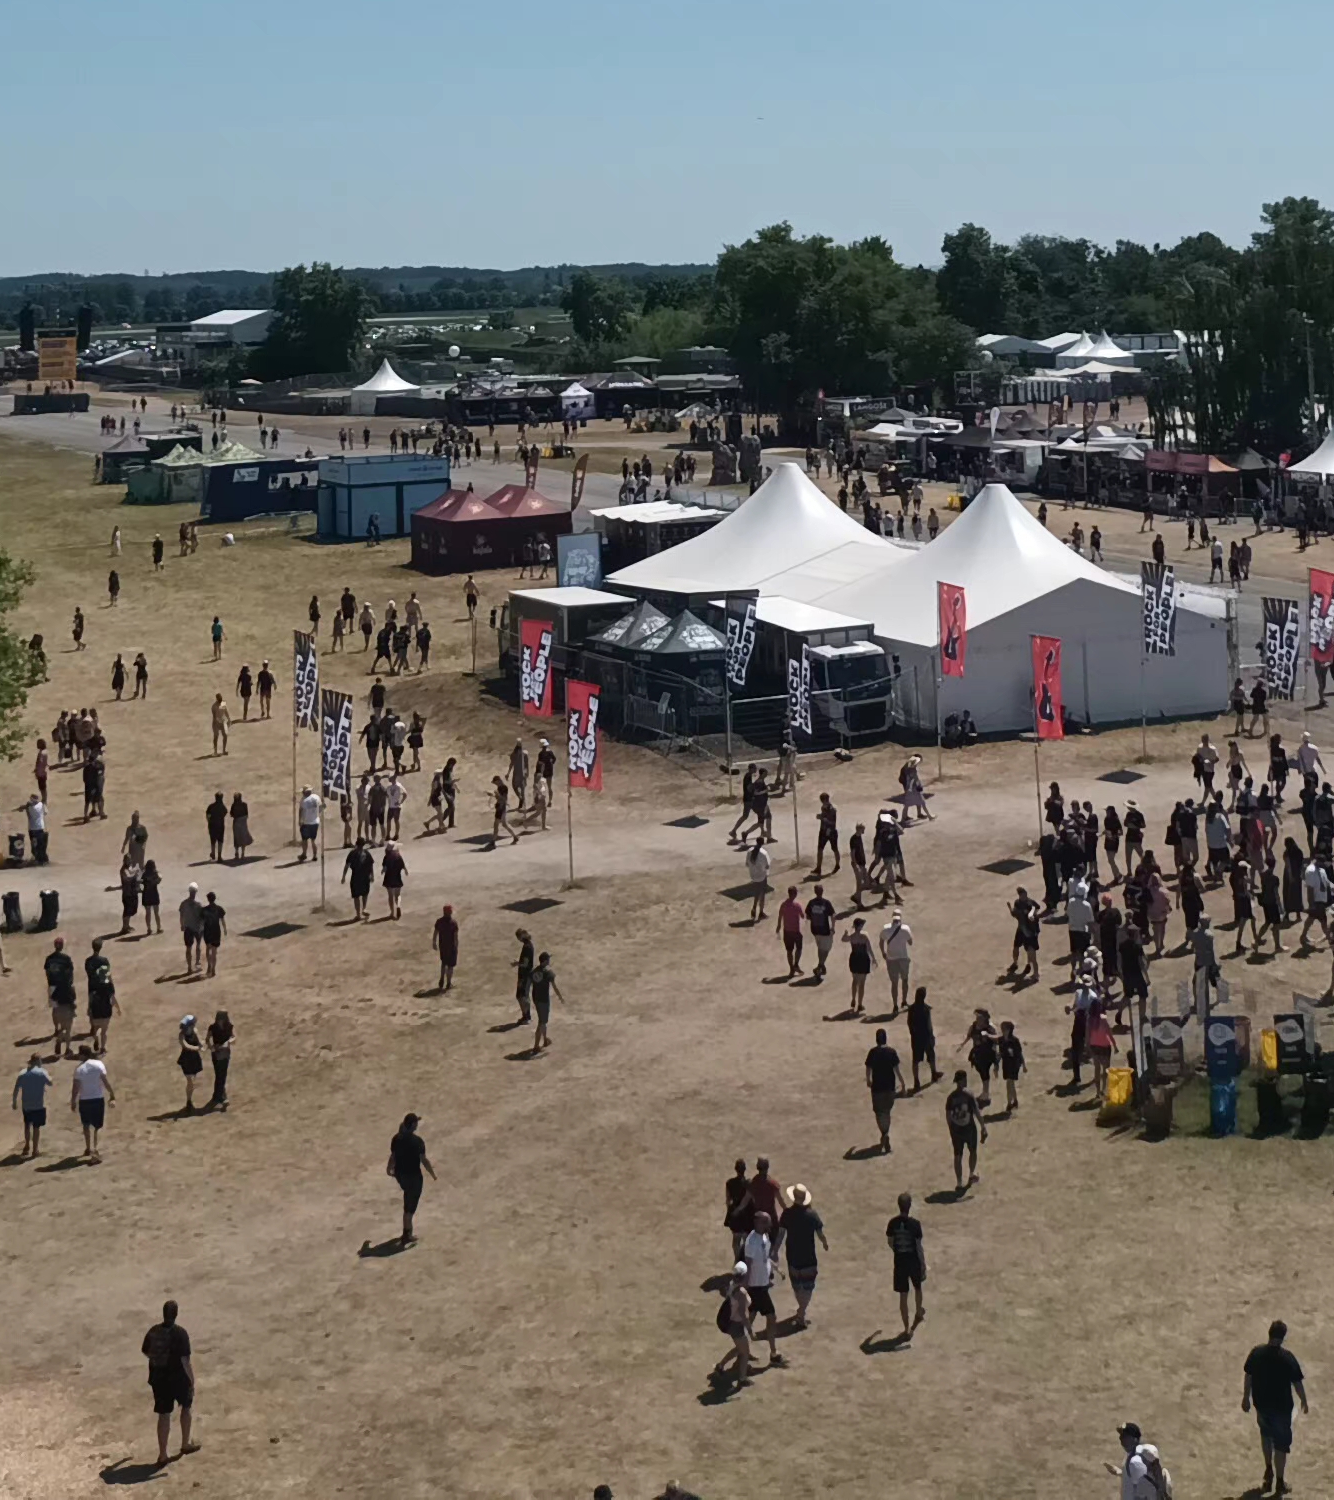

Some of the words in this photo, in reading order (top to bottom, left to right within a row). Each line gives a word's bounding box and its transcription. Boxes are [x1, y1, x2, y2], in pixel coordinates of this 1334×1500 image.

[1144, 588, 1154, 637] ROCK
[1160, 575, 1173, 644] PEOPLE
[1267, 627, 1277, 683] ROCK
[1282, 612, 1298, 689] PEOPLE
